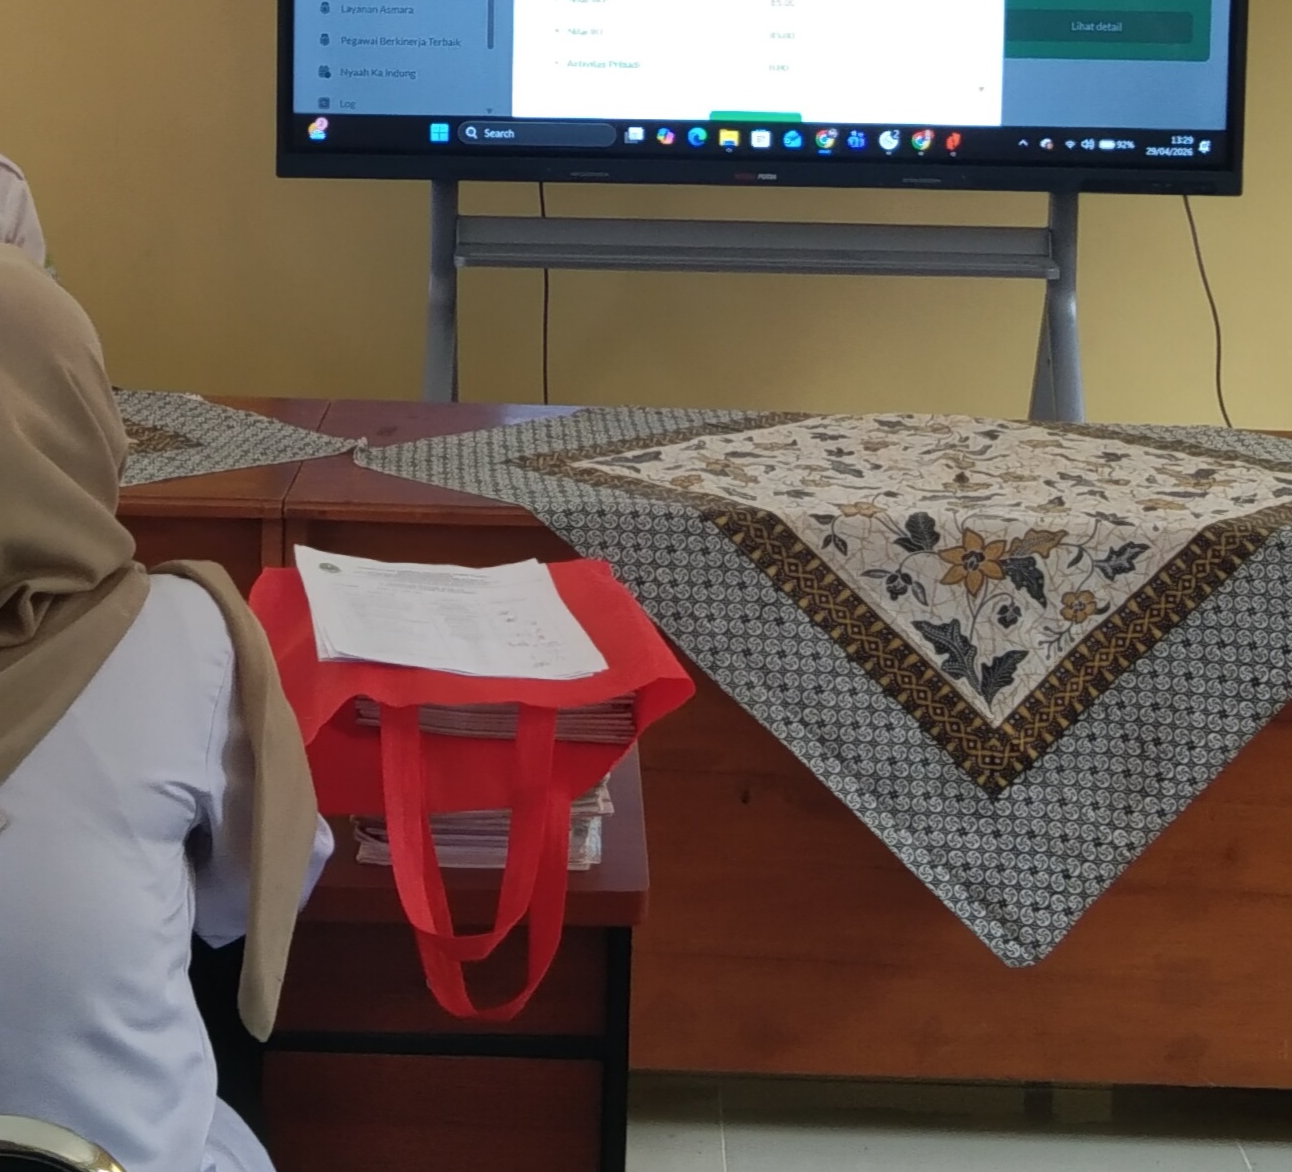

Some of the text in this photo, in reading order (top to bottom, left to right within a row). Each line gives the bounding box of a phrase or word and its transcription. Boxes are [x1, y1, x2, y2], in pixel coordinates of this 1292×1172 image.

[341, 5, 414, 15] Layanan Asmara
[1071, 22, 1123, 32] Lihat detail
[341, 37, 461, 48] Pegawai Berkinerja Terbaik
[340, 68, 366, 79] Nyaah
[385, 69, 416, 79] Indung
[340, 100, 356, 110] Log
[484, 129, 515, 139] Search
[1116, 140, 1135, 149] 92%
[1171, 136, 1194, 145] 13:29
[1146, 147, 1193, 156] 29/04/2026
